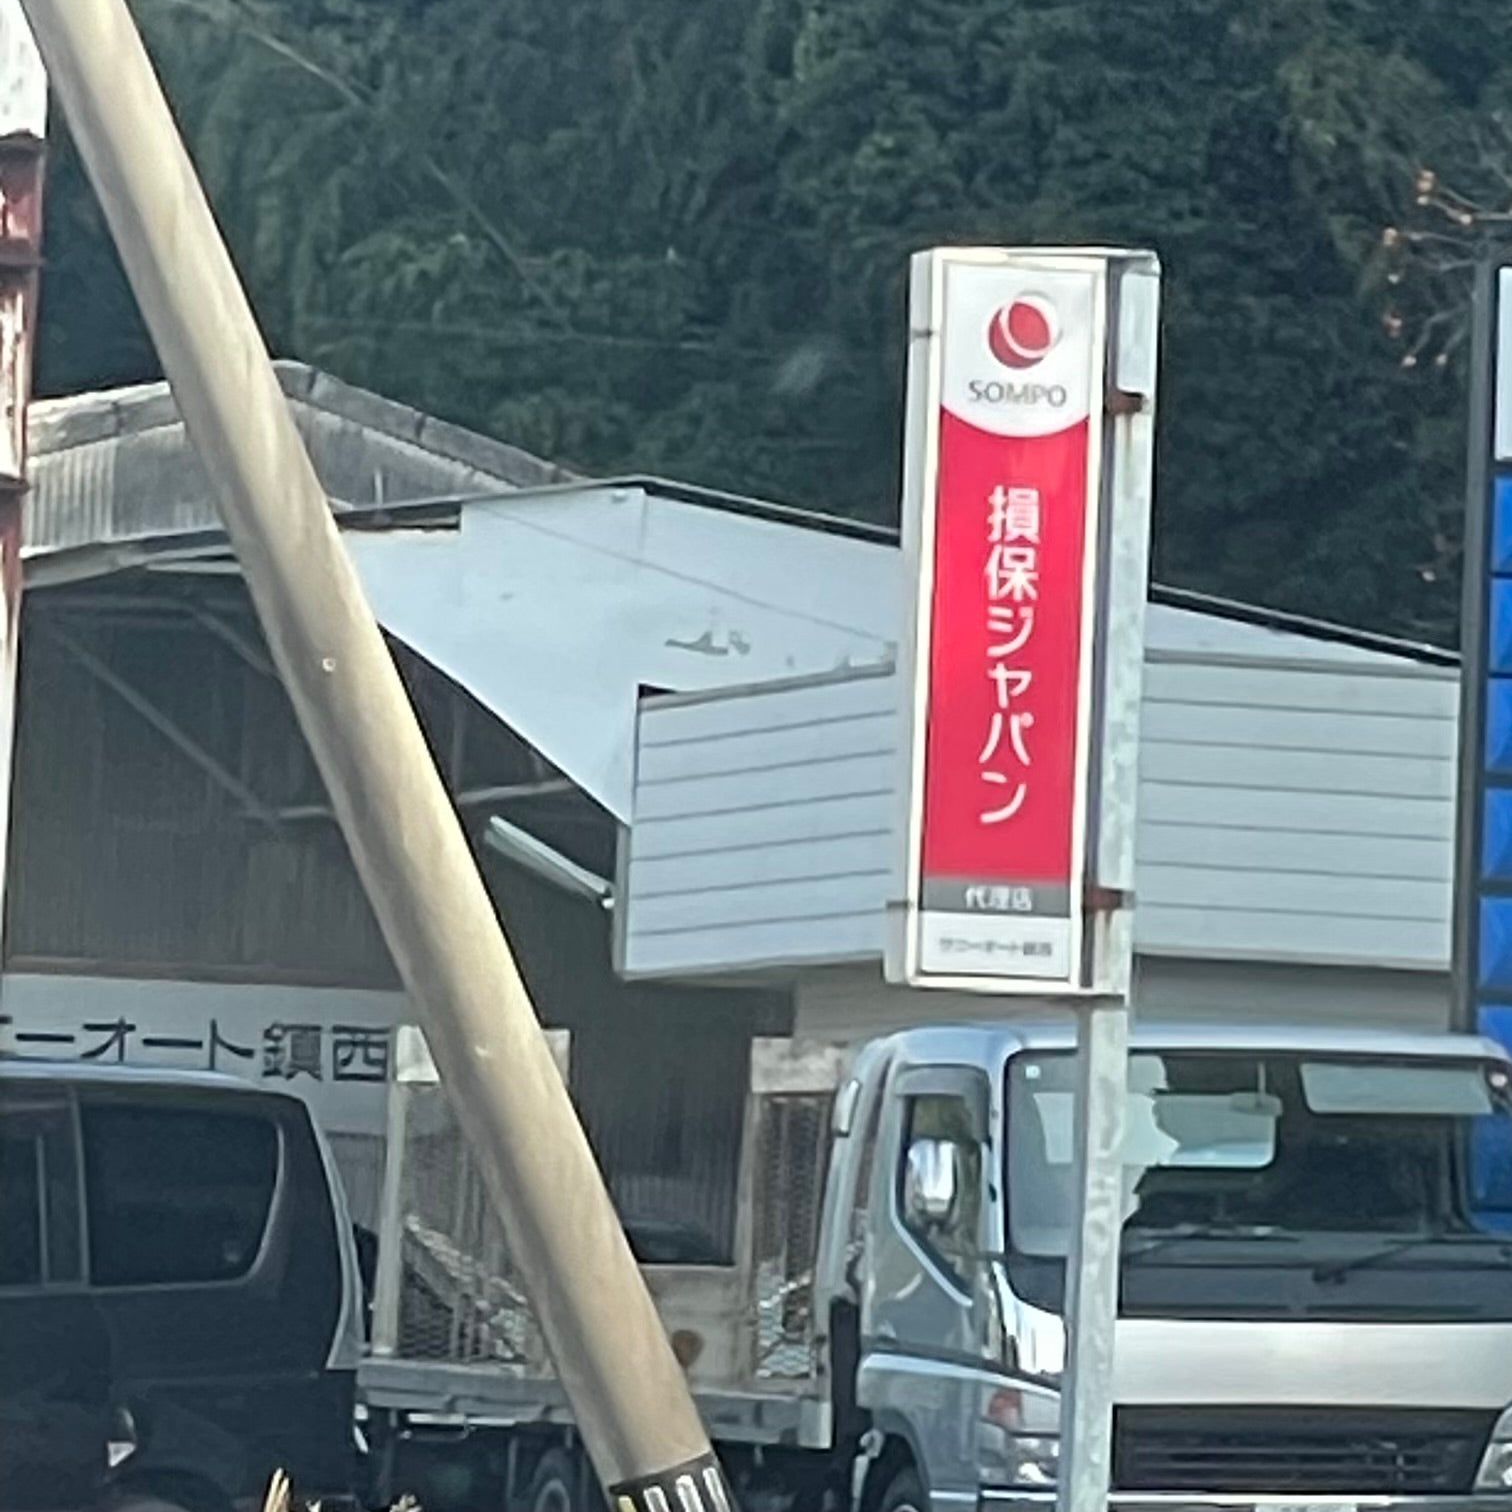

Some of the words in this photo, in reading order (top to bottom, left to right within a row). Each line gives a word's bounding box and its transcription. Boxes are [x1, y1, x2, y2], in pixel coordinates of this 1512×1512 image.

[968, 379, 1067, 407] SOMPO
[978, 485, 1040, 823] 損保ジャパン
